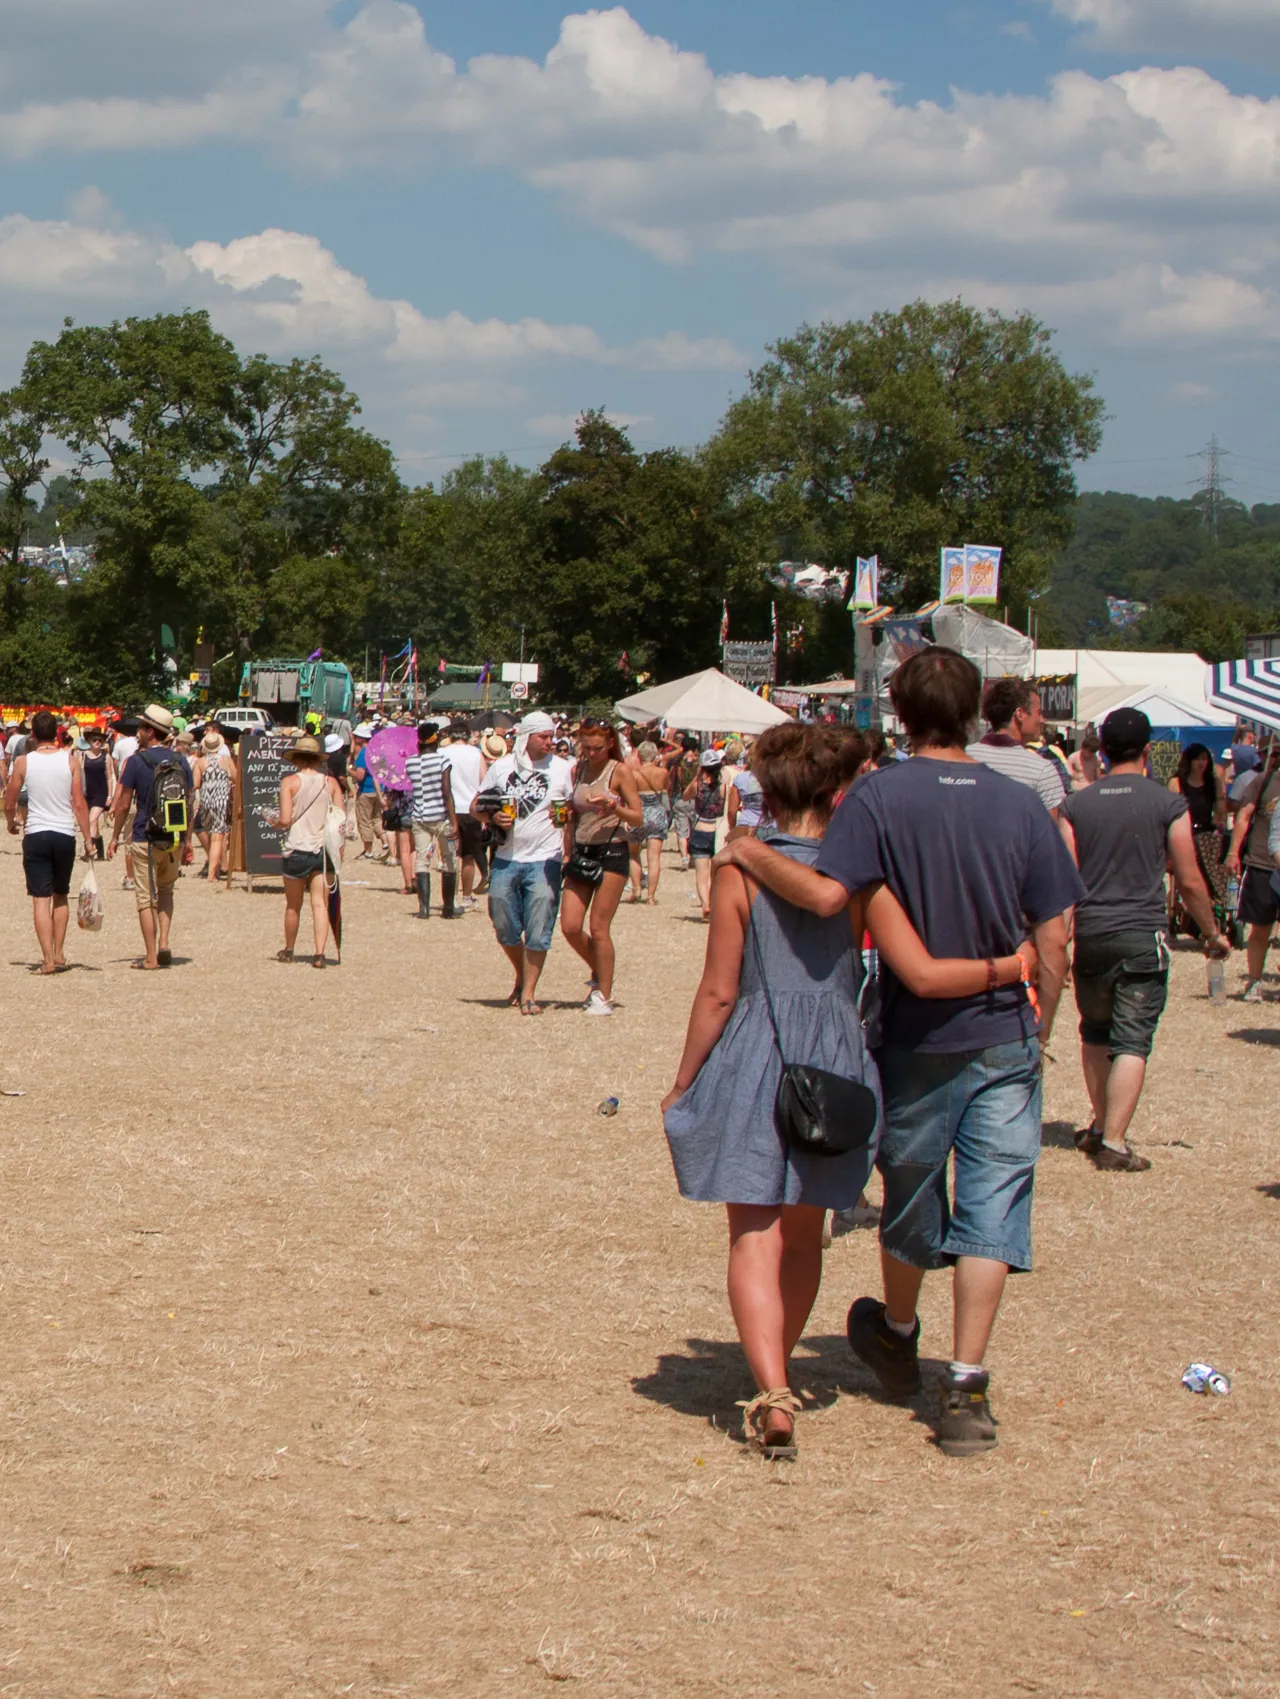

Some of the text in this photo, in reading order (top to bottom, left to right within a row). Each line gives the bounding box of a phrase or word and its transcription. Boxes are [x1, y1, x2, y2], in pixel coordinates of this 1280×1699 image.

[259, 737, 299, 749] PIZZ
[247, 750, 282, 760] MEAL
[247, 764, 265, 774] ANY
[280, 765, 298, 773] DEE
